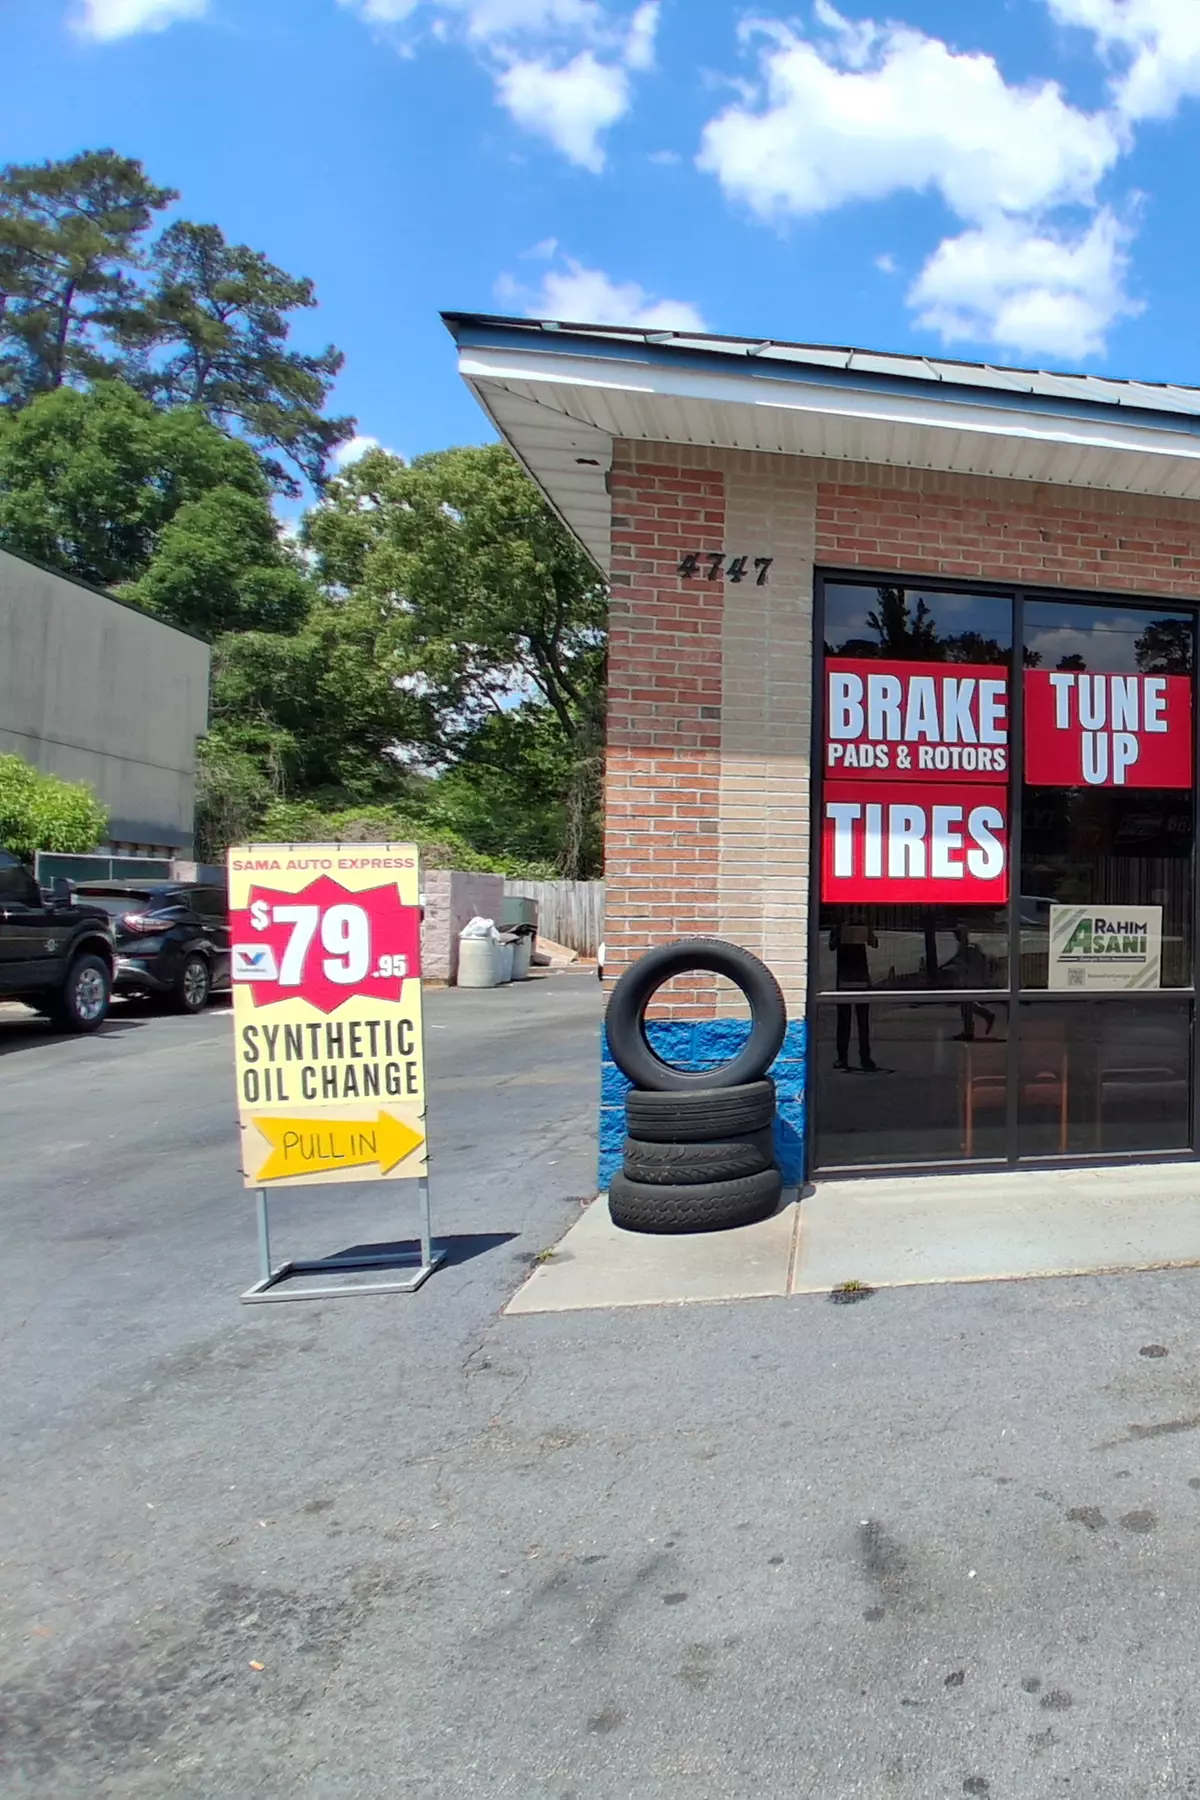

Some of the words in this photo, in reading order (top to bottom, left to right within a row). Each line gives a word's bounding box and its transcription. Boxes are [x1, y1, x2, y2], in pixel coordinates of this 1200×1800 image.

[677, 553, 774, 586] 4747
[827, 672, 1007, 744] BRAKE
[1049, 673, 1168, 732] TUNE
[827, 743, 889, 769] PADS
[896, 745, 912, 770] &
[918, 745, 1007, 772] ROTORS
[1080, 731, 1139, 785] UP
[825, 802, 1005, 879] TIRES
[232, 859, 281, 871] SAMA
[286, 859, 332, 870] AUTO
[338, 858, 415, 870] EXPRESS
[1062, 918, 1147, 953] ASANI
[1094, 919, 1147, 934] RAHIM
[242, 1018, 415, 1063] SYNTHETIC
[243, 1067, 289, 1102] OIL
[302, 1061, 419, 1099] CHANGE
[284, 1131, 345, 1160] PULL
[351, 1130, 378, 1156] IN
